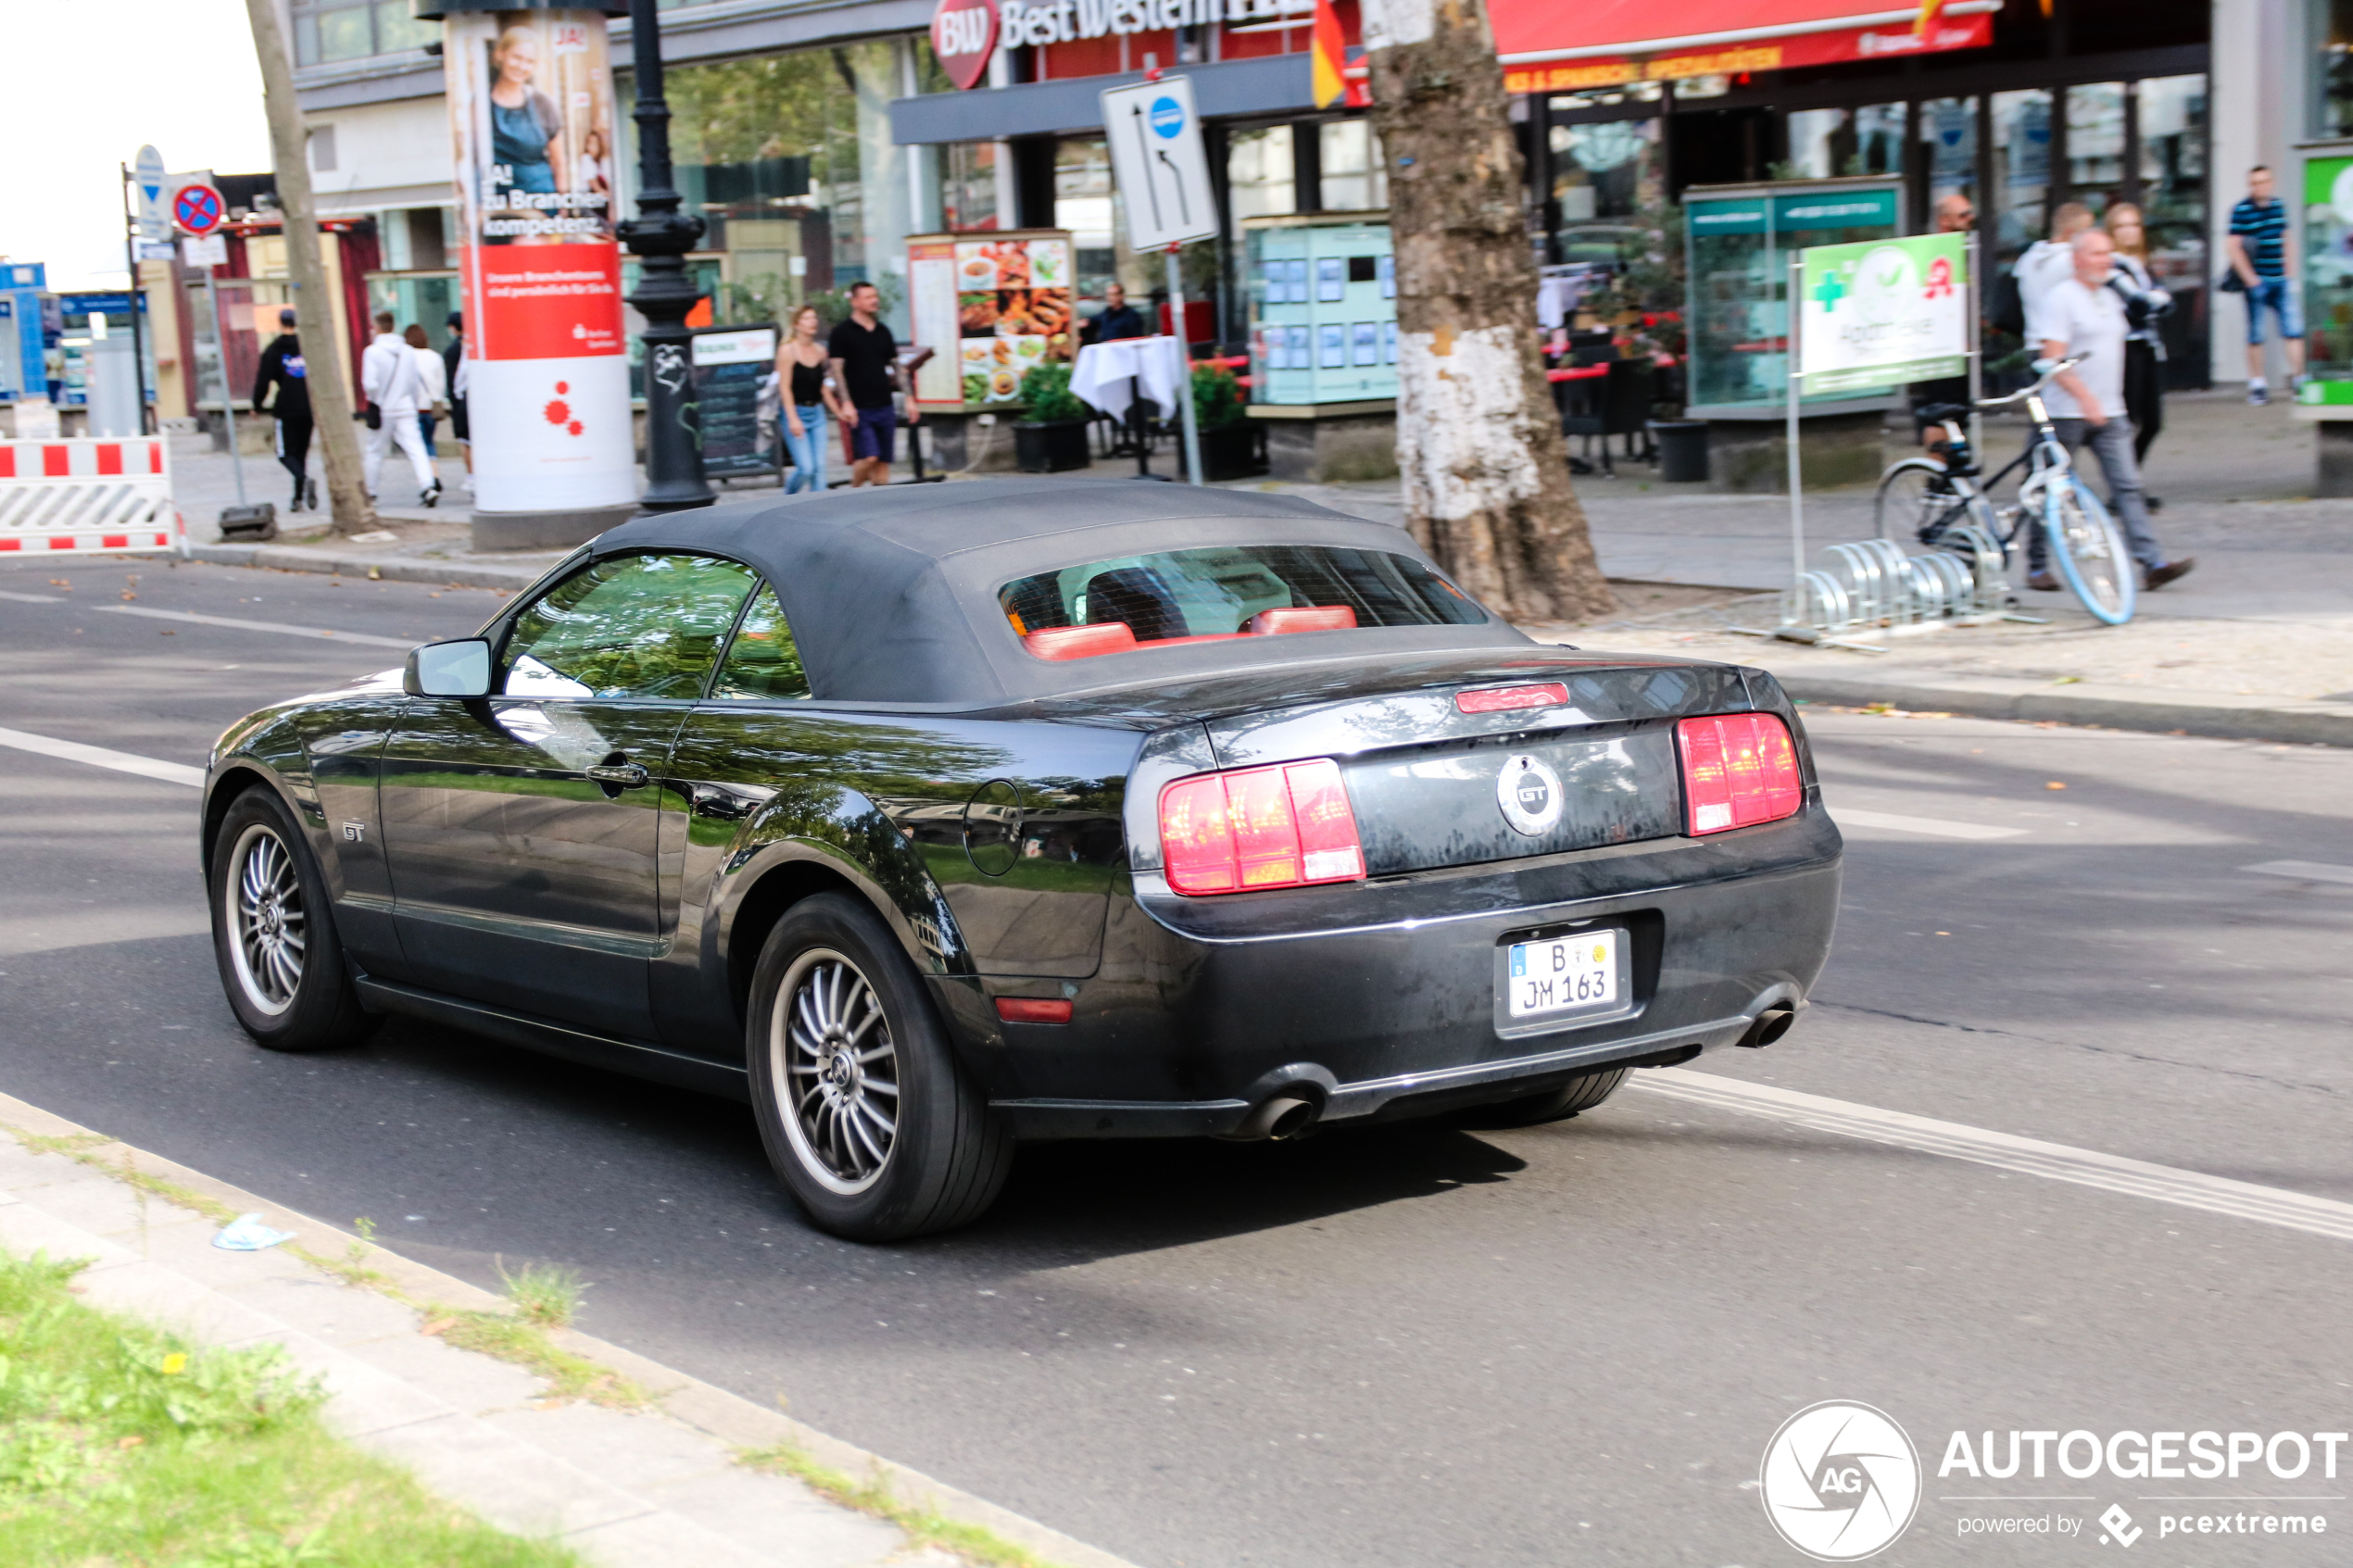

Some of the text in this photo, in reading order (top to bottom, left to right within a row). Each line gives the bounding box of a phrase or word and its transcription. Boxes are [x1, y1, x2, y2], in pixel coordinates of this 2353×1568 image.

[1001, 1, 1075, 49] Best
[482, 194, 507, 210] zu
[1518, 786, 1546, 802] GT
[343, 822, 365, 841] GT
[1553, 945, 1566, 972] B
[1516, 965, 1523, 975] D
[1524, 971, 1604, 1009] JM 163
